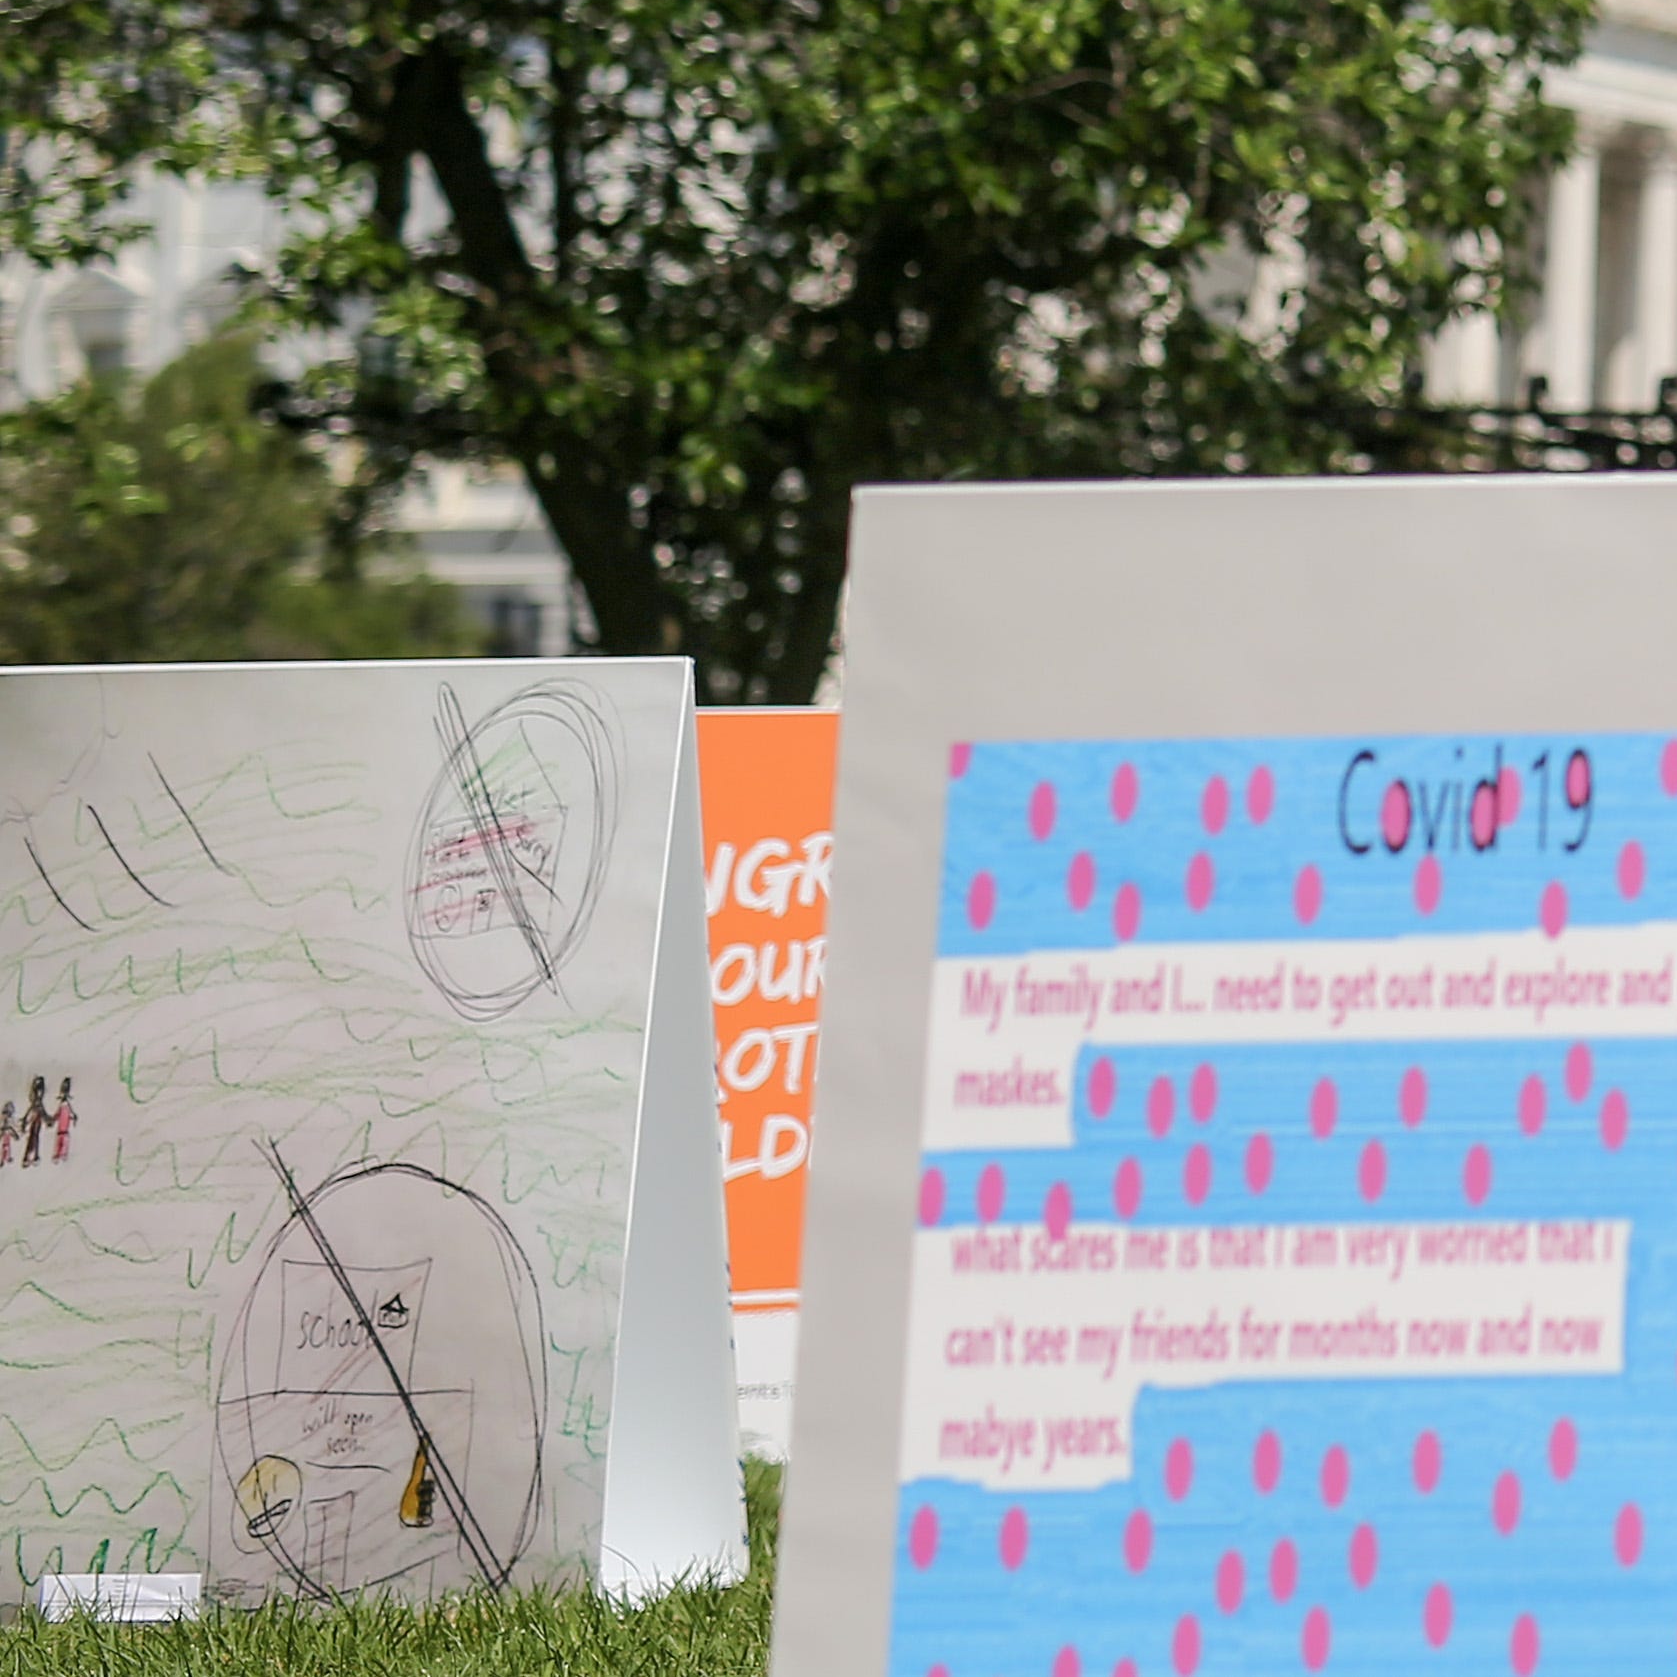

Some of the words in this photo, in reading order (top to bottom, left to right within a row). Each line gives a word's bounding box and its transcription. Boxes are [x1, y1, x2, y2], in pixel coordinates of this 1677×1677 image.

[1338, 744, 1502, 854] Covid
[1531, 747, 1593, 853] 19
[961, 968, 1007, 1034] My
[1014, 962, 1105, 1031] family
[1110, 963, 1167, 1015] and
[1213, 959, 1285, 1012] need
[1292, 967, 1325, 1011] to
[1328, 966, 1380, 1028] get
[1383, 964, 1436, 1010] out
[1440, 958, 1499, 1009] and
[1503, 956, 1613, 1024] explore
[1617, 956, 1675, 1007] and
[953, 1054, 1065, 1108] maskes.
[952, 1226, 1024, 1272] what
[1029, 1227, 1119, 1273] scares
[1124, 1233, 1172, 1271] me
[1177, 1233, 1201, 1271] is
[1208, 1229, 1268, 1269] that
[1291, 1230, 1339, 1268] am
[1346, 1229, 1411, 1282] very
[1417, 1226, 1529, 1266] worried
[1537, 1224, 1596, 1264] that
[297, 1288, 379, 1350] school
[944, 1316, 1017, 1368] can't
[1020, 1326, 1070, 1366] see
[1076, 1325, 1125, 1380] my
[1129, 1307, 1232, 1363] friends
[1238, 1306, 1285, 1362] for
[1288, 1304, 1399, 1359] months
[1406, 1319, 1471, 1359] now
[1476, 1303, 1533, 1358] and
[1539, 1316, 1605, 1356] now
[939, 1403, 1038, 1474] mabye
[1041, 1416, 1126, 1473] years.
